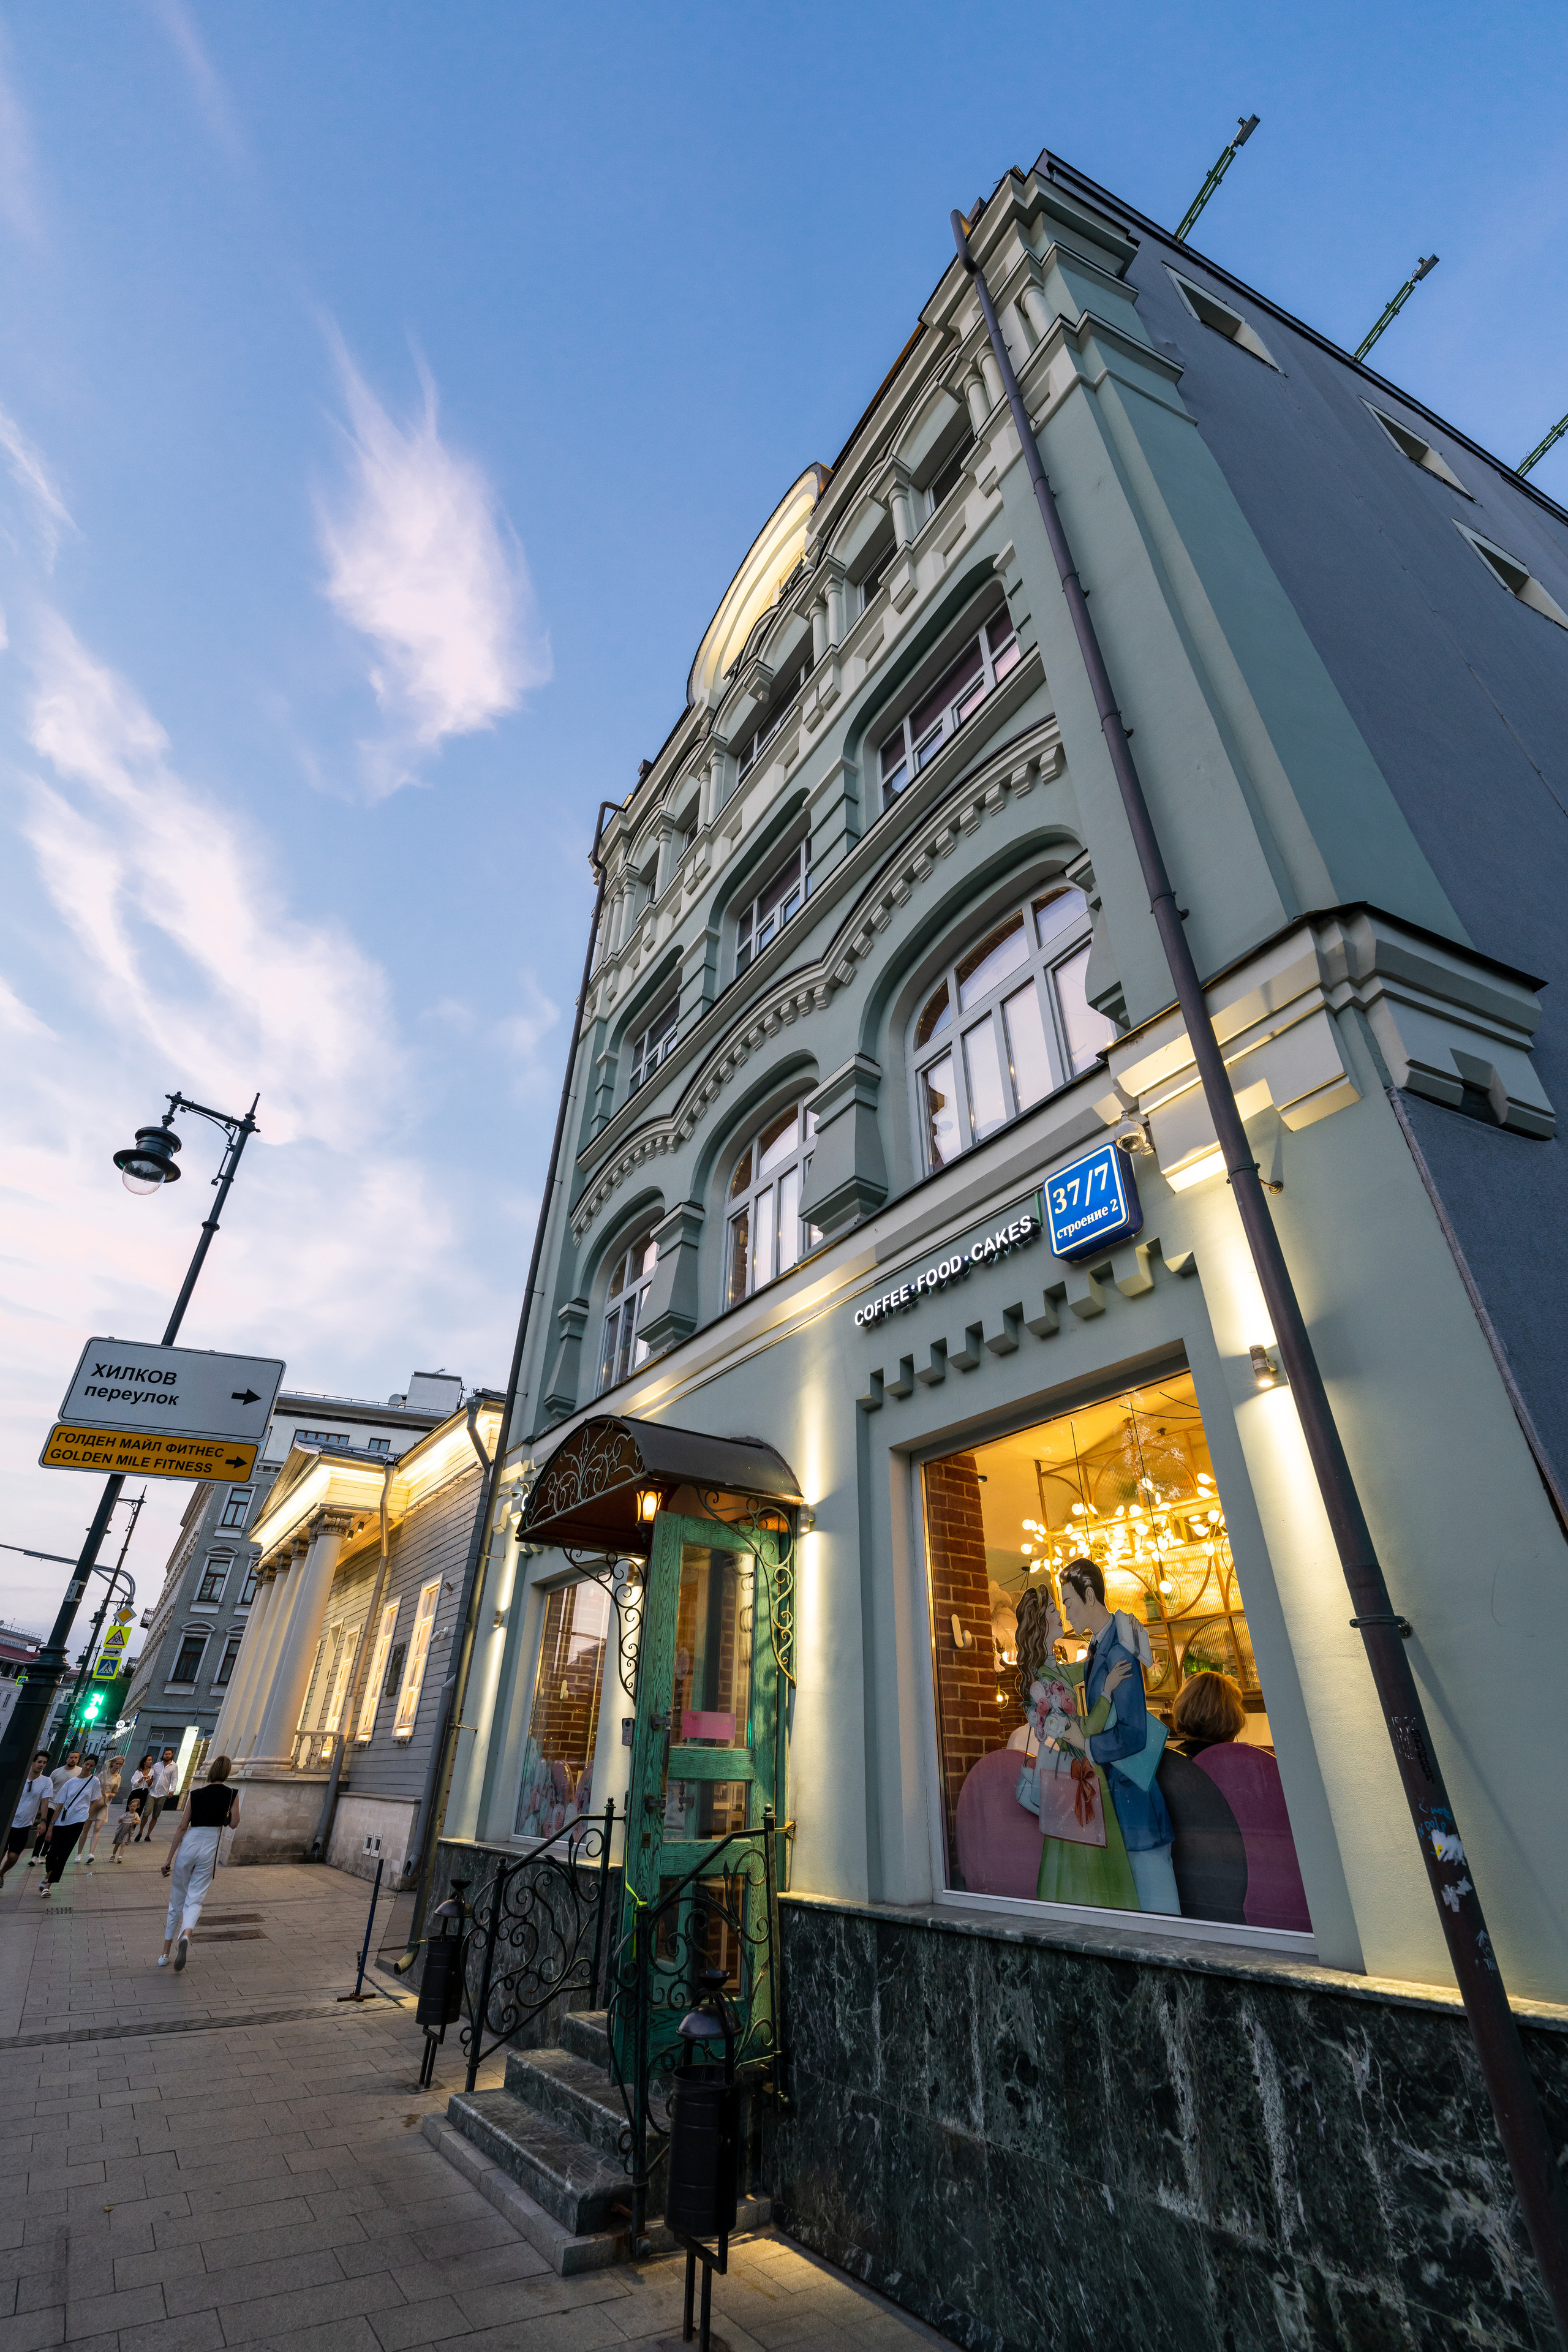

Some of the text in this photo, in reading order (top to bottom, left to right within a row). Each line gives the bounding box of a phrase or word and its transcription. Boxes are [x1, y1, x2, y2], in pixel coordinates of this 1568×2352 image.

[1052, 1162, 1108, 1214] 37/7
[1057, 1199, 1118, 1239] строение 2
[854, 1284, 910, 1326] COFFEE
[971, 1215, 1032, 1261] CAKES
[91, 1363, 178, 1385] ХИЛКОВ
[84, 1385, 179, 1406] переулок
[56, 1432, 225, 1458] ГОЛДЕН МАЙЛ ФИТНЕС
[50, 1449, 213, 1473] GOLDEN MILE FITNESS
[89, 1693, 104, 1706] 34
